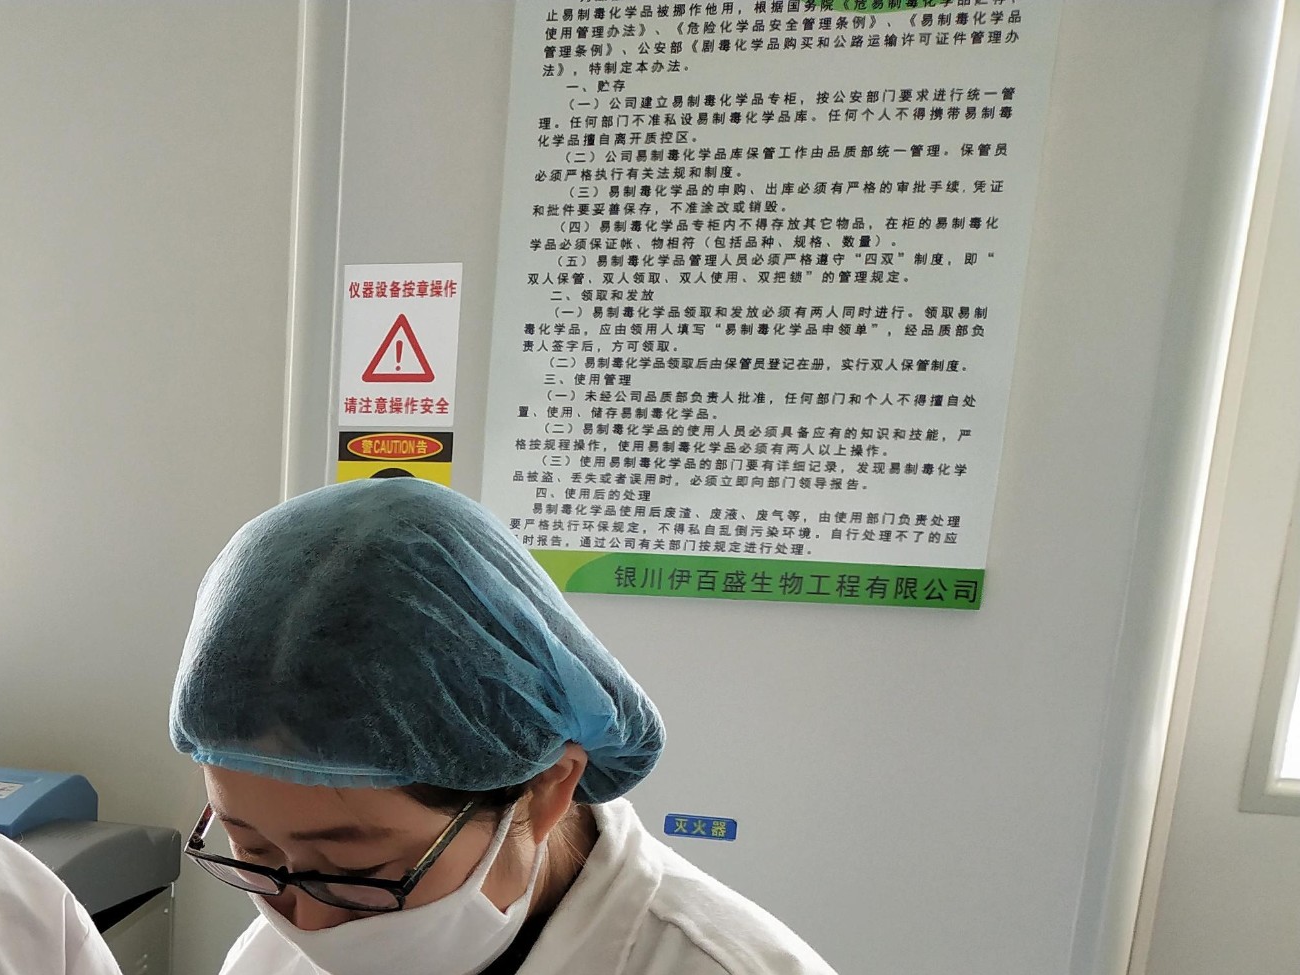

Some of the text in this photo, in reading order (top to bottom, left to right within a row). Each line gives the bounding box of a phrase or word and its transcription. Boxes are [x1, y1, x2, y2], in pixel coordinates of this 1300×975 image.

[545, 10, 1022, 40] 使用管理办法》、《危险化学品安全管理条例》、《易制毒化学品
[544, 29, 1020, 58] 管理条例》、公安部《剧毒化学品购买和公路运输许可证件管理办
[542, 59, 690, 77] 法》，特制定本办法。
[566, 79, 626, 94] 一、贮存
[538, 105, 1013, 130] 理。任何部门不准私设易制毒化学品库。任何个人不得携带易制毒
[538, 130, 698, 148] 化学品擅自离开质控区。
[535, 165, 744, 182] 必须严格执行有关法规和制度。
[532, 200, 787, 217] 和批件要妥善保存，不准涂改或销毁。
[348, 279, 458, 299] 仪器设备按章操作
[550, 289, 655, 302] 二、领取和发放
[522, 340, 679, 353] 责人签字后，方可领取。
[544, 373, 632, 386] 三、使用管理
[344, 397, 450, 415] 请注意操作安全
[518, 406, 719, 420] 置、使用、储存易制毒化学品。
[536, 487, 651, 502] 四、使用后的处理
[514, 534, 813, 556] 时报告，通过公司有关部门按规定进行处理。
[614, 565, 978, 604] 银川伊百盛生物工程有限公司
[673, 818, 727, 837] 灭火器
